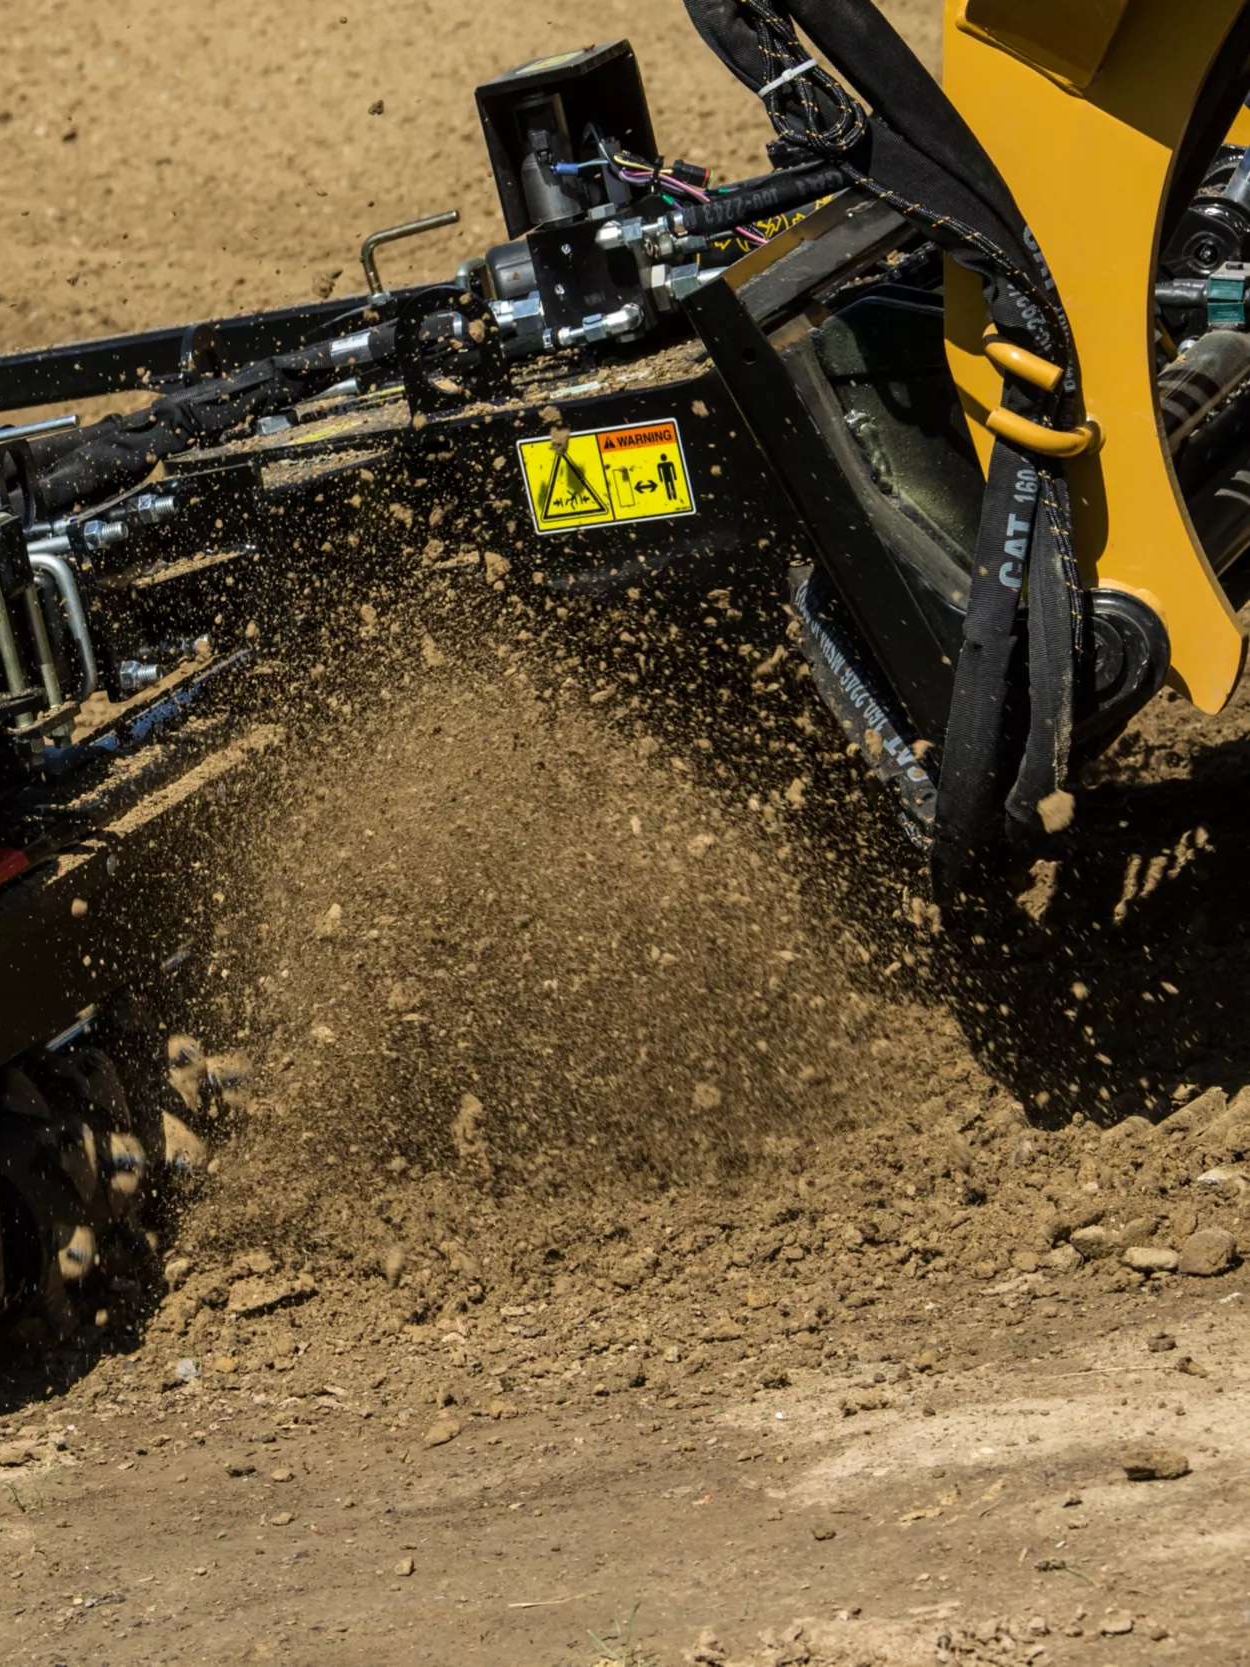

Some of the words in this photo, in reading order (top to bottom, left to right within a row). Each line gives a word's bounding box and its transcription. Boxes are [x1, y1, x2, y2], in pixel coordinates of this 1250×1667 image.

[617, 430, 672, 447] WARNING
[999, 513, 1032, 589] CAT
[883, 735, 930, 782] CAT
